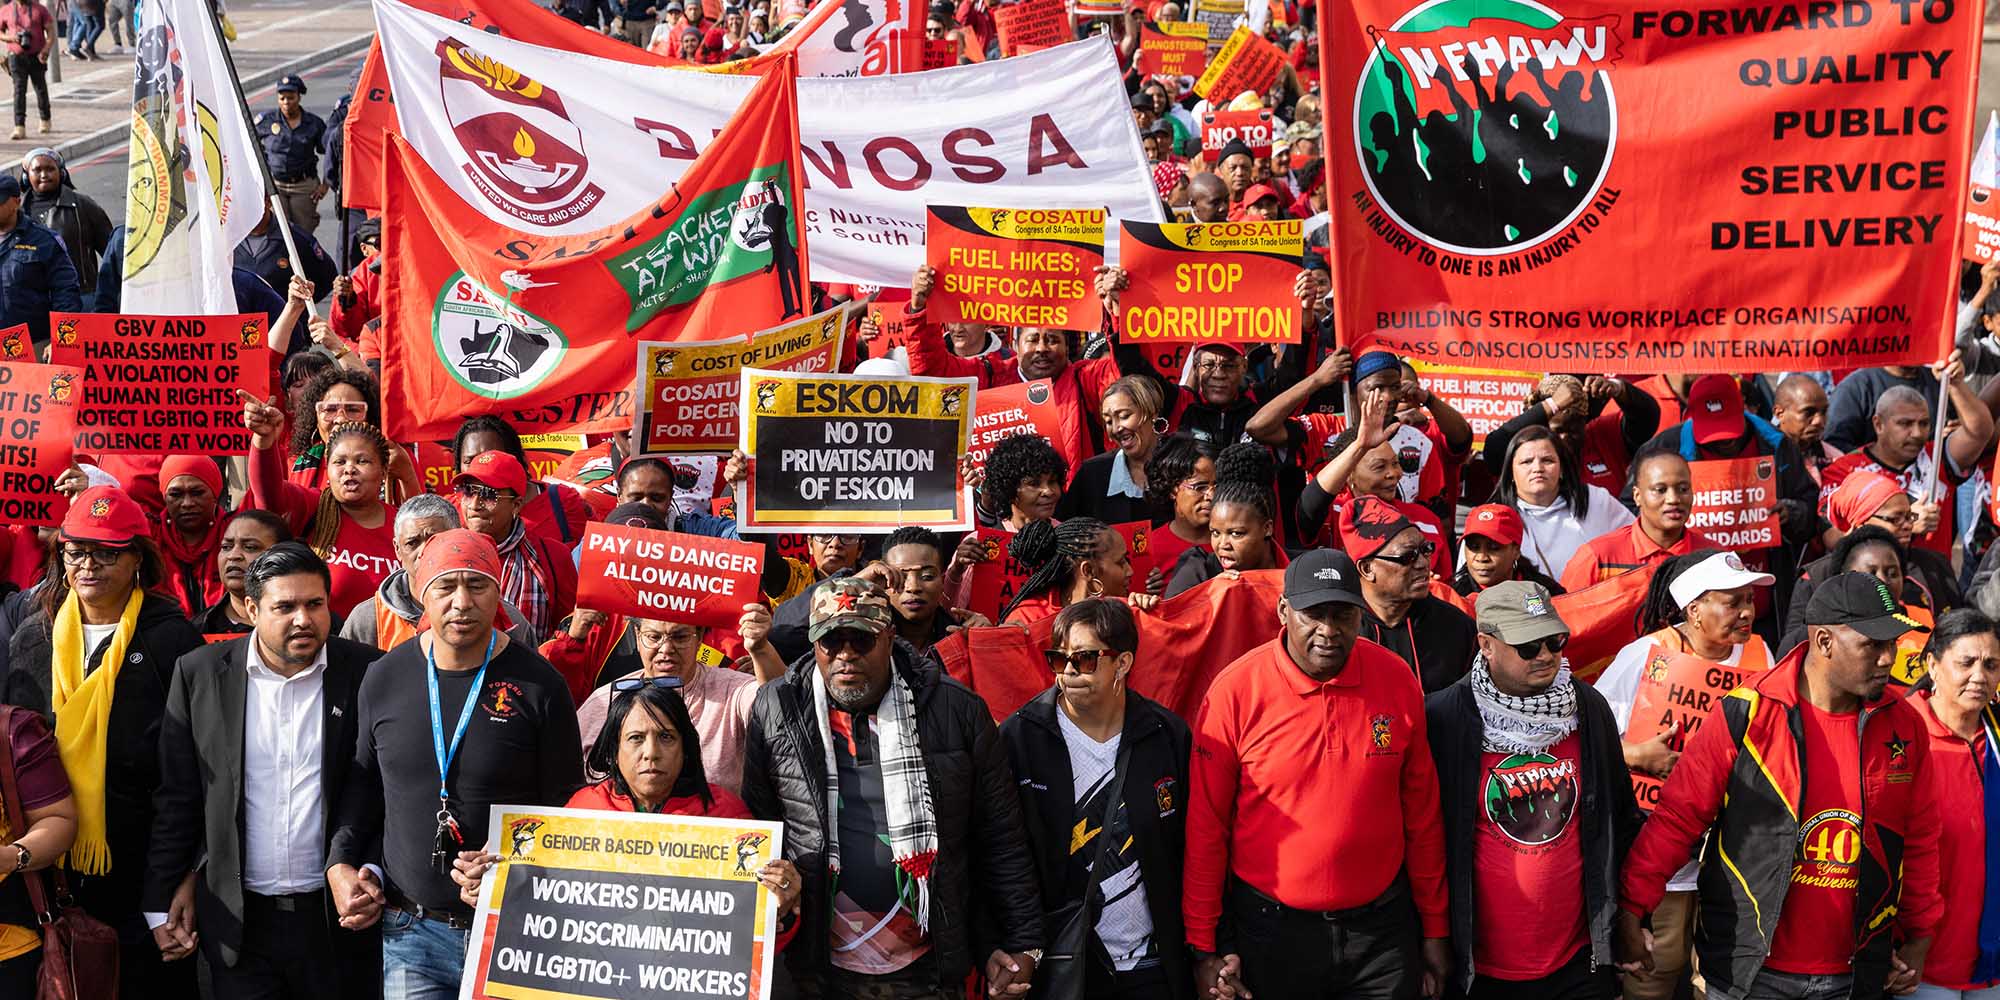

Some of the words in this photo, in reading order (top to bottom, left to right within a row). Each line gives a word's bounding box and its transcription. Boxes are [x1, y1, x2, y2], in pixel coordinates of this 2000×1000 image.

[1632, 0, 1873, 39] FORWARD
[1891, 0, 1954, 25] TO
[1143, 40, 1205, 50] GANGSTERISM
[1162, 53, 1186, 62] MUST
[1400, 26, 1607, 88] NEHAWU
[1162, 65, 1183, 75] FALL
[1739, 50, 1953, 88] QUALITY
[1773, 105, 1949, 140] PUBLIC
[1208, 127, 1237, 144] NO
[1240, 126, 1267, 141] TO
[1740, 160, 1946, 196] SERVICE
[470, 171, 502, 204] UNITED
[502, 199, 519, 215] WE
[520, 208, 547, 224] CARE
[548, 208, 569, 223] AND
[568, 191, 597, 216] SHARE
[1014, 210, 1104, 224] COSATU
[833, 228, 909, 246] South
[1015, 225, 1044, 235] Congress
[1045, 225, 1052, 234] of
[1052, 225, 1062, 233] SA
[1063, 225, 1081, 234] Trade
[1082, 226, 1103, 234] Unions
[1208, 221, 1301, 237] COSATU
[1353, 190, 1370, 214] AN
[1366, 212, 1417, 258] INJURY
[1417, 247, 1436, 268] TO
[1440, 257, 1472, 276] ONE
[1478, 260, 1493, 277] IS
[1499, 259, 1522, 276] AN
[1526, 236, 1579, 270] INJURY
[1577, 213, 1599, 235] TO
[1599, 187, 1621, 217] ALL
[1711, 214, 1944, 250] DELIVERY
[1210, 238, 1240, 247] Congress
[1241, 238, 1248, 246] of
[1249, 238, 1259, 246] SA
[1260, 238, 1278, 246] Trade
[1279, 237, 1301, 246] Unions
[950, 247, 1004, 269] FUEL
[1010, 251, 1081, 275] HIKES;
[639, 254, 674, 296] AT
[944, 274, 1085, 299] SUFFOCATES
[1175, 263, 1243, 293] STOP
[960, 301, 1068, 326] WORKERS
[1126, 306, 1291, 338] CORRUPTION
[1376, 309, 1482, 330] BUILDING
[1489, 309, 1580, 330] STRONG
[1588, 307, 1727, 330] WORKPLACE
[1734, 304, 1912, 327] ORGANISATION,
[114, 319, 155, 338] GBV
[162, 319, 206, 337] AND
[84, 341, 217, 361] HARASSMENT
[221, 342, 238, 360] IS
[691, 353, 736, 372] COST
[740, 349, 761, 366] OF
[765, 333, 812, 359] LIVING
[1158, 346, 1183, 368] of
[1445, 340, 1628, 360] CONSCIOUSNESS
[1635, 341, 1685, 360] AND
[1692, 334, 1910, 359] INTERNATIONALISM
[84, 365, 98, 383] A
[103, 364, 209, 384] VIOLATION
[214, 365, 240, 384] OF
[84, 387, 161, 406] HUMAN
[167, 388, 242, 406] RIGHTS!
[662, 380, 740, 402] COSATU
[796, 383, 919, 414] ESKOM
[1433, 379, 1462, 394] FUEL
[1464, 380, 1499, 395] HIKES
[23, 393, 42, 414] IS
[10, 418, 41, 441] OF
[143, 410, 215, 430] LGBTIQ
[656, 423, 694, 437] FOR
[701, 424, 735, 437] ALL
[973, 408, 1029, 429] NISTER,
[74, 432, 162, 451] VIOLENCE
[169, 432, 190, 450] AT
[196, 432, 251, 450] WORK
[537, 434, 546, 443] SA
[547, 434, 562, 442] Trade
[563, 434, 580, 442] Unions
[824, 422, 859, 444] NO
[863, 422, 892, 444] TO
[983, 422, 1038, 445] SECTOR
[782, 449, 935, 473] PRIVATISATION
[801, 477, 829, 500] OF
[832, 476, 914, 500] ESKOM
[1745, 488, 1765, 502] TO
[1738, 508, 1769, 524] AND
[589, 533, 632, 553] PAY
[636, 541, 664, 559] US
[669, 545, 757, 574] DANGER
[603, 561, 735, 596] ALLOWANCE
[1001, 581, 1014, 598] A
[638, 590, 697, 614] NOW!
[1819, 811, 1839, 821] UNION
[1839, 811, 1848, 819] OF
[541, 833, 601, 853] GENDER
[604, 838, 654, 857] BASED
[658, 841, 730, 862] VIOLENCE
[1807, 827, 1861, 864] 40
[1817, 860, 1850, 876] Years
[532, 875, 639, 910] WORKERS
[643, 886, 735, 916] DEMAND
[522, 913, 557, 939] NO
[561, 919, 732, 956] DISCRIMINATION
[497, 947, 532, 974] ON
[535, 951, 632, 987] LGBTIQ+
[638, 963, 747, 997] WORKERS
